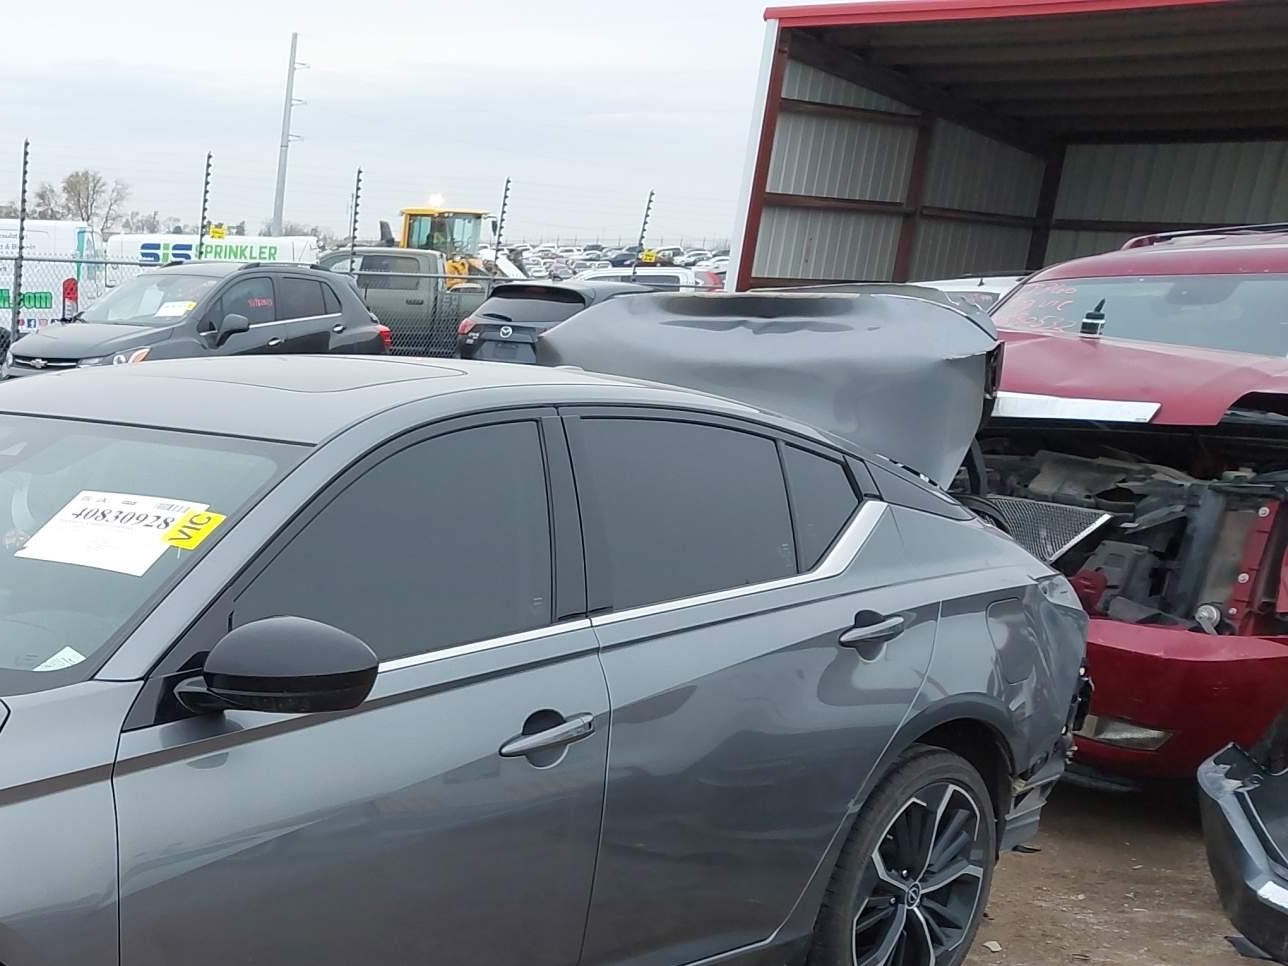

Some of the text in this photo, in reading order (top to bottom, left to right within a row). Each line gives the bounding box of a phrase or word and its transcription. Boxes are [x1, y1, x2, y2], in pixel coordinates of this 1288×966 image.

[195, 244, 277, 260] SPRINKLER
[71, 507, 175, 530] 40830928
[168, 513, 212, 542] VIC
